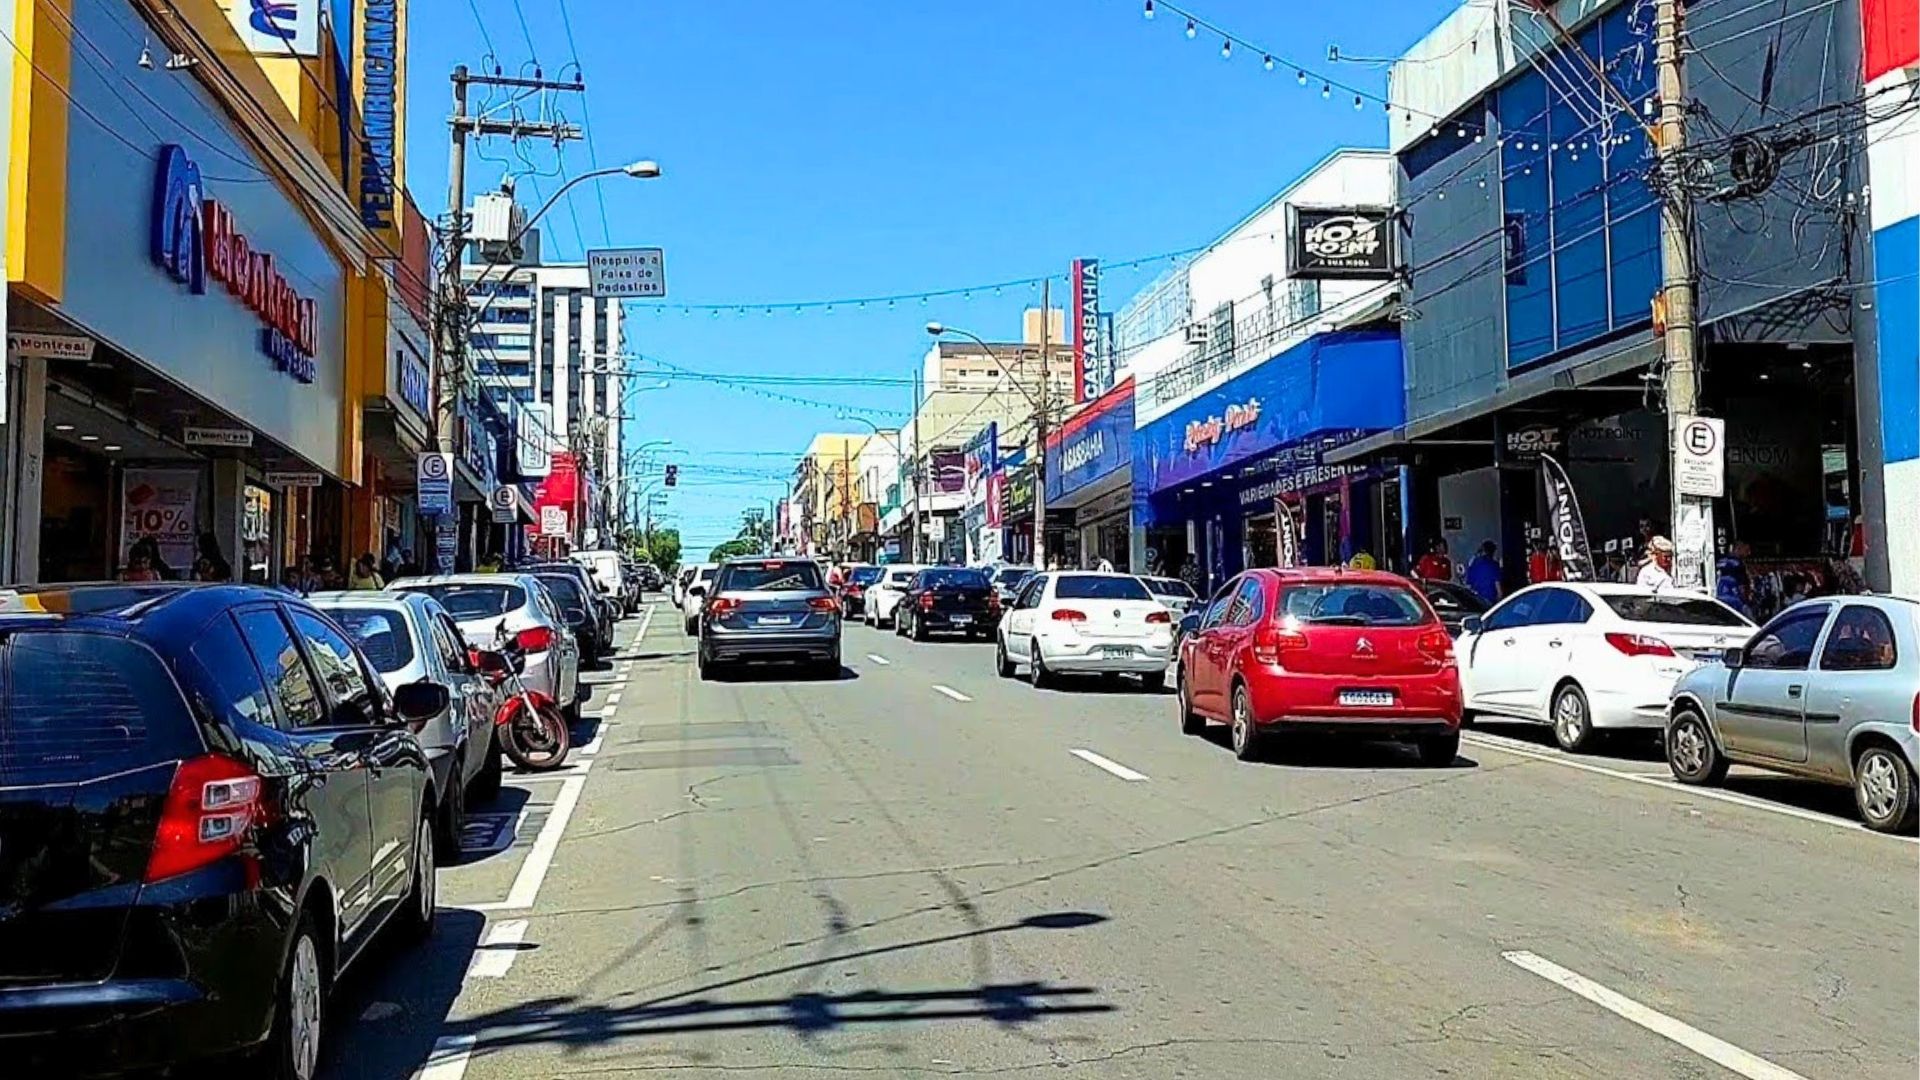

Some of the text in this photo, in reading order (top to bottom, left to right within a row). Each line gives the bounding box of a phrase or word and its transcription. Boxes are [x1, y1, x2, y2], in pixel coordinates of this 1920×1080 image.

[361, 0, 394, 229] PERNAMBUCANA
[1305, 222, 1377, 242] HOT
[1306, 240, 1380, 255] POINT
[592, 255, 659, 267] Respeite a
[202, 199, 319, 358] Montreal
[601, 269, 653, 279] Faixa de
[597, 283, 658, 293] Pedestres
[1082, 263, 1099, 400] CASASBAHIA
[20, 338, 86, 351] Montreal
[1507, 428, 1559, 444] HOT
[1507, 441, 1561, 451] POINT
[1691, 426, 1708, 449] E
[1238, 474, 1294, 505] VARIEDADES
[1295, 473, 1302, 489] E
[1555, 478, 1576, 560] POINT
[1281, 513, 1293, 568] POINT
